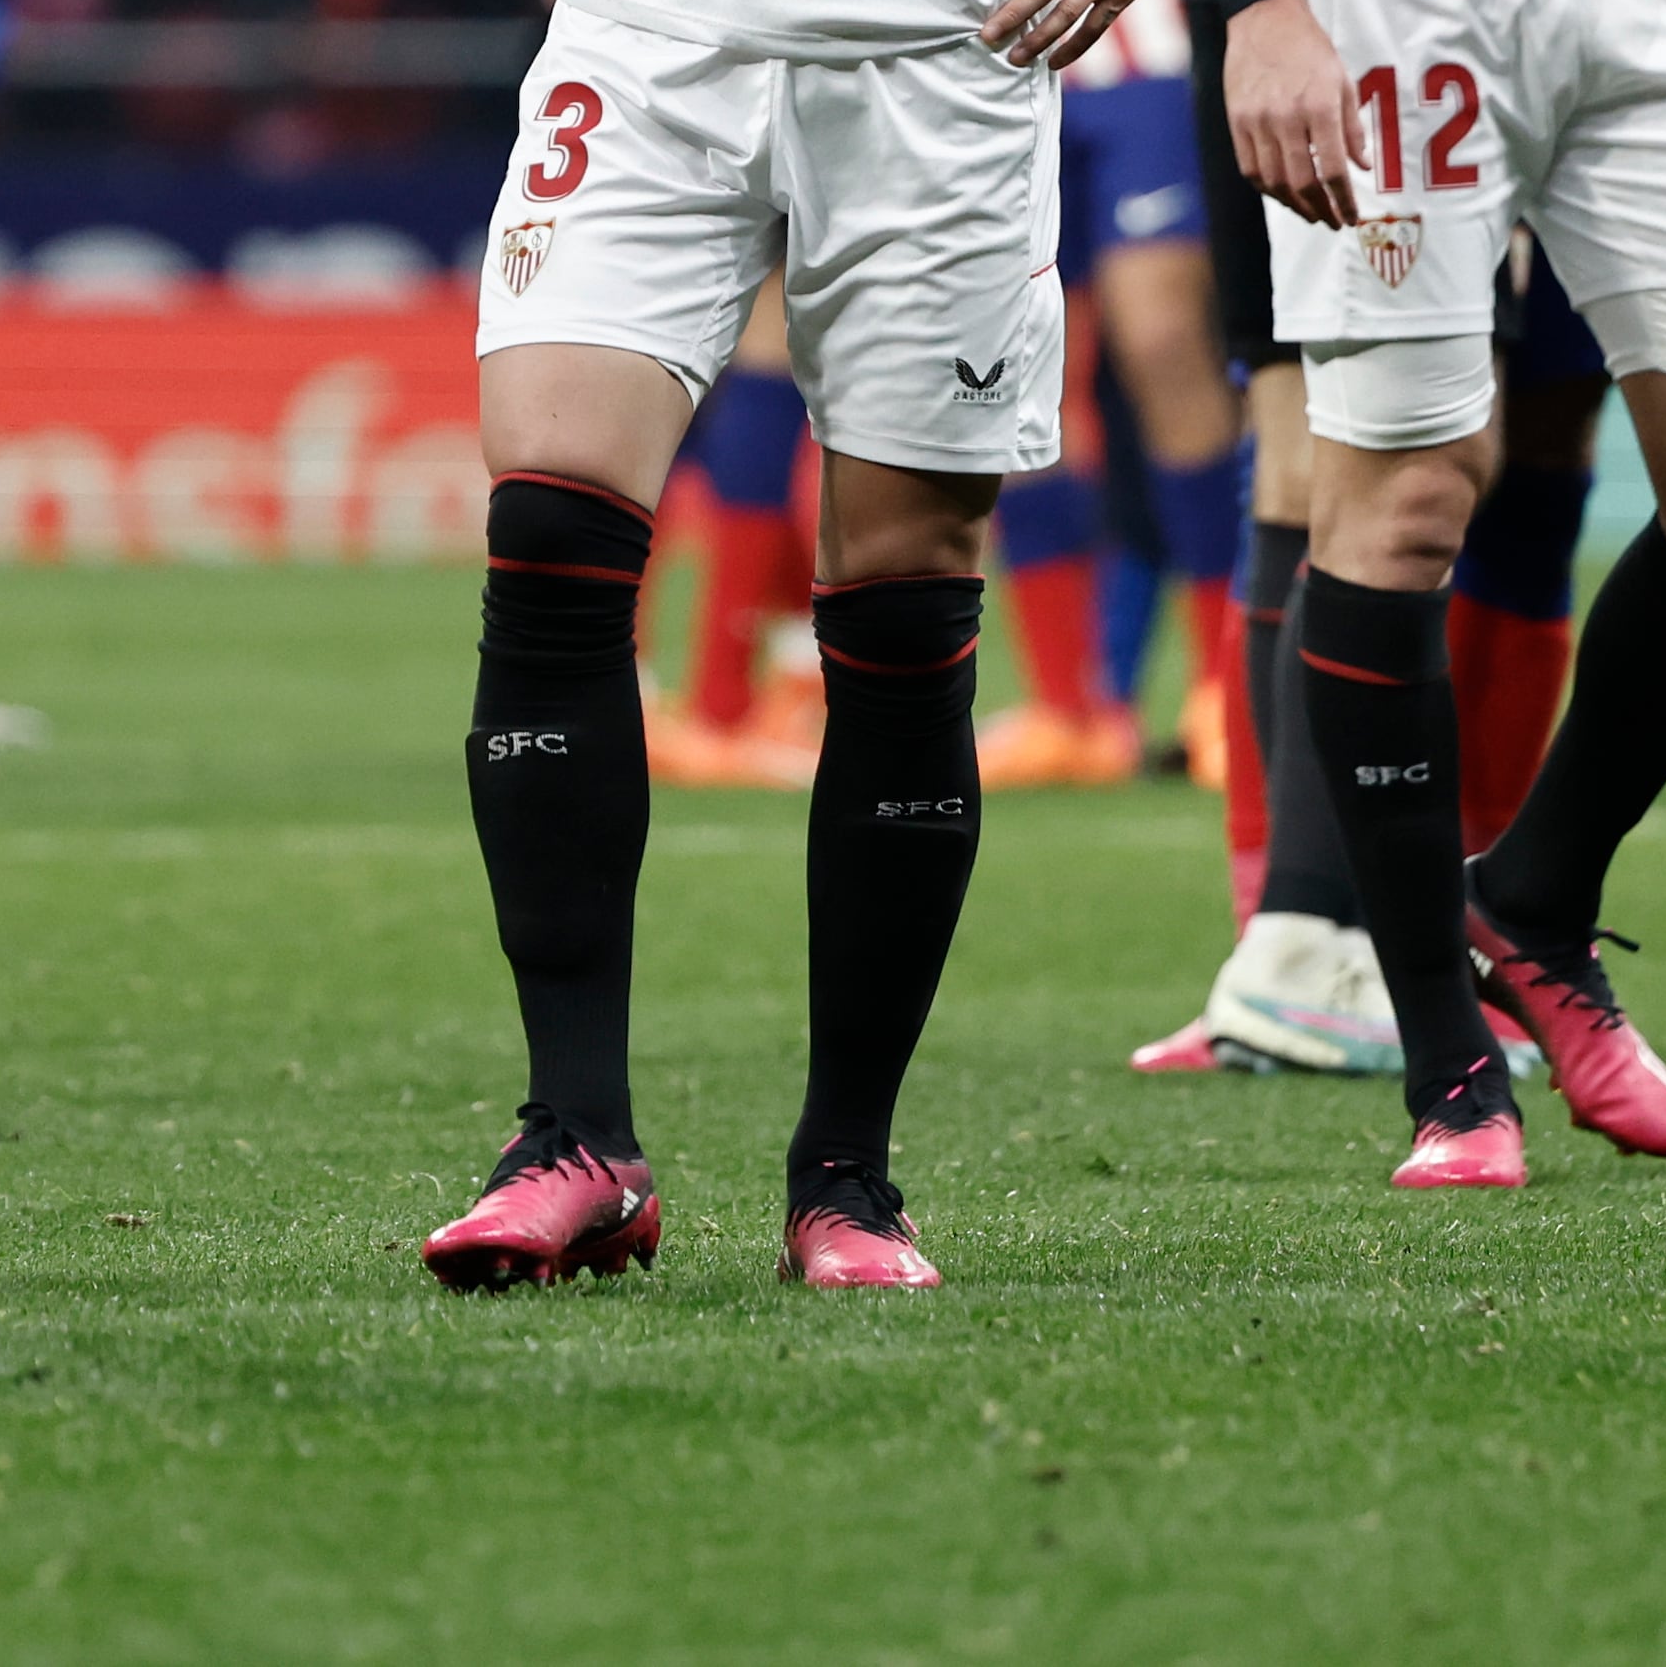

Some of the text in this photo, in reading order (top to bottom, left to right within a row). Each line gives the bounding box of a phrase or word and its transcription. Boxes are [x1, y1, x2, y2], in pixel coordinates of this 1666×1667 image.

[522, 80, 604, 203] 3
[1357, 62, 1481, 193] 12
[488, 731, 568, 763] SFC
[1355, 762, 1430, 786] SFC
[876, 797, 963, 818] SFC
